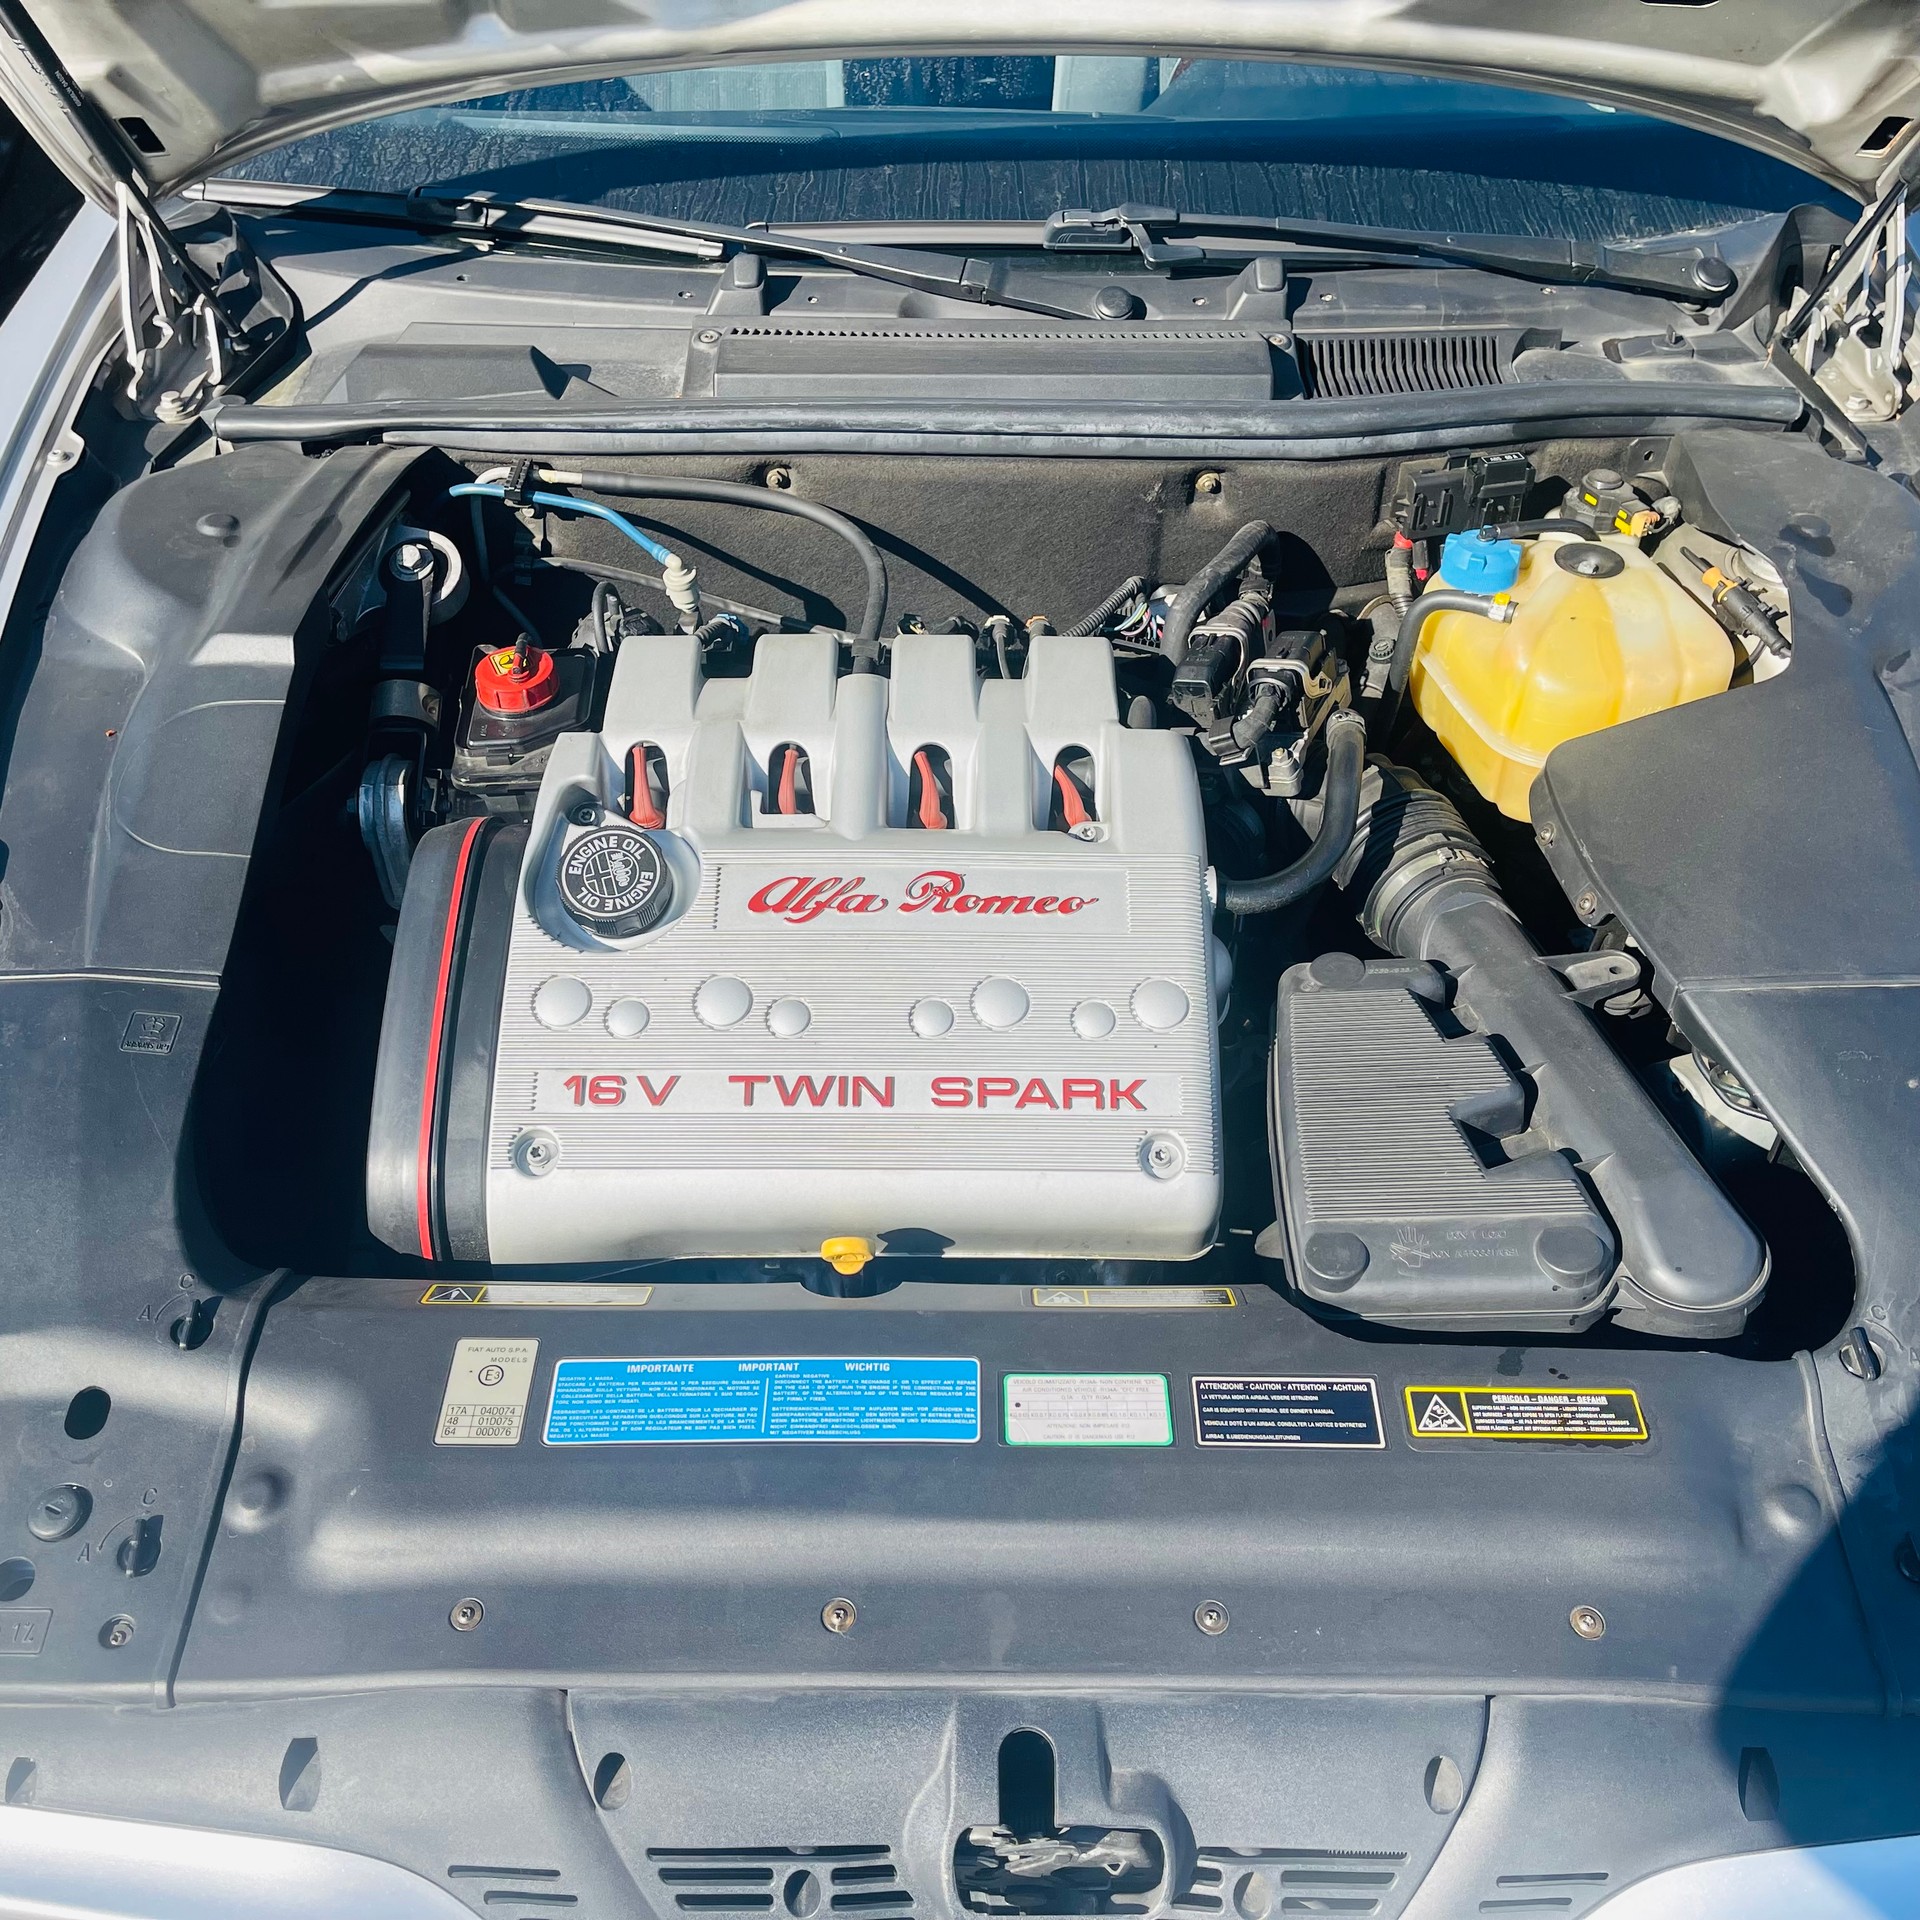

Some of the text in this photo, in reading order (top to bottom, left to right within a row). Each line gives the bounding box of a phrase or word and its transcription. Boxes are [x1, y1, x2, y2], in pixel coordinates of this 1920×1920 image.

[568, 835, 646, 875] ENGINE OIL
[576, 871, 654, 911] ENGINE OIL
[747, 870, 1099, 924] Alfa Romeo
[728, 1075, 894, 1107] TWIN
[931, 1076, 1147, 1111] SPARK
[627, 1362, 890, 1374] IMPORTANTE IMPORTANT WICHTIG
[447, 1417, 459, 1425] 48
[450, 1407, 467, 1415] 17A
[444, 1427, 456, 1436] 64
